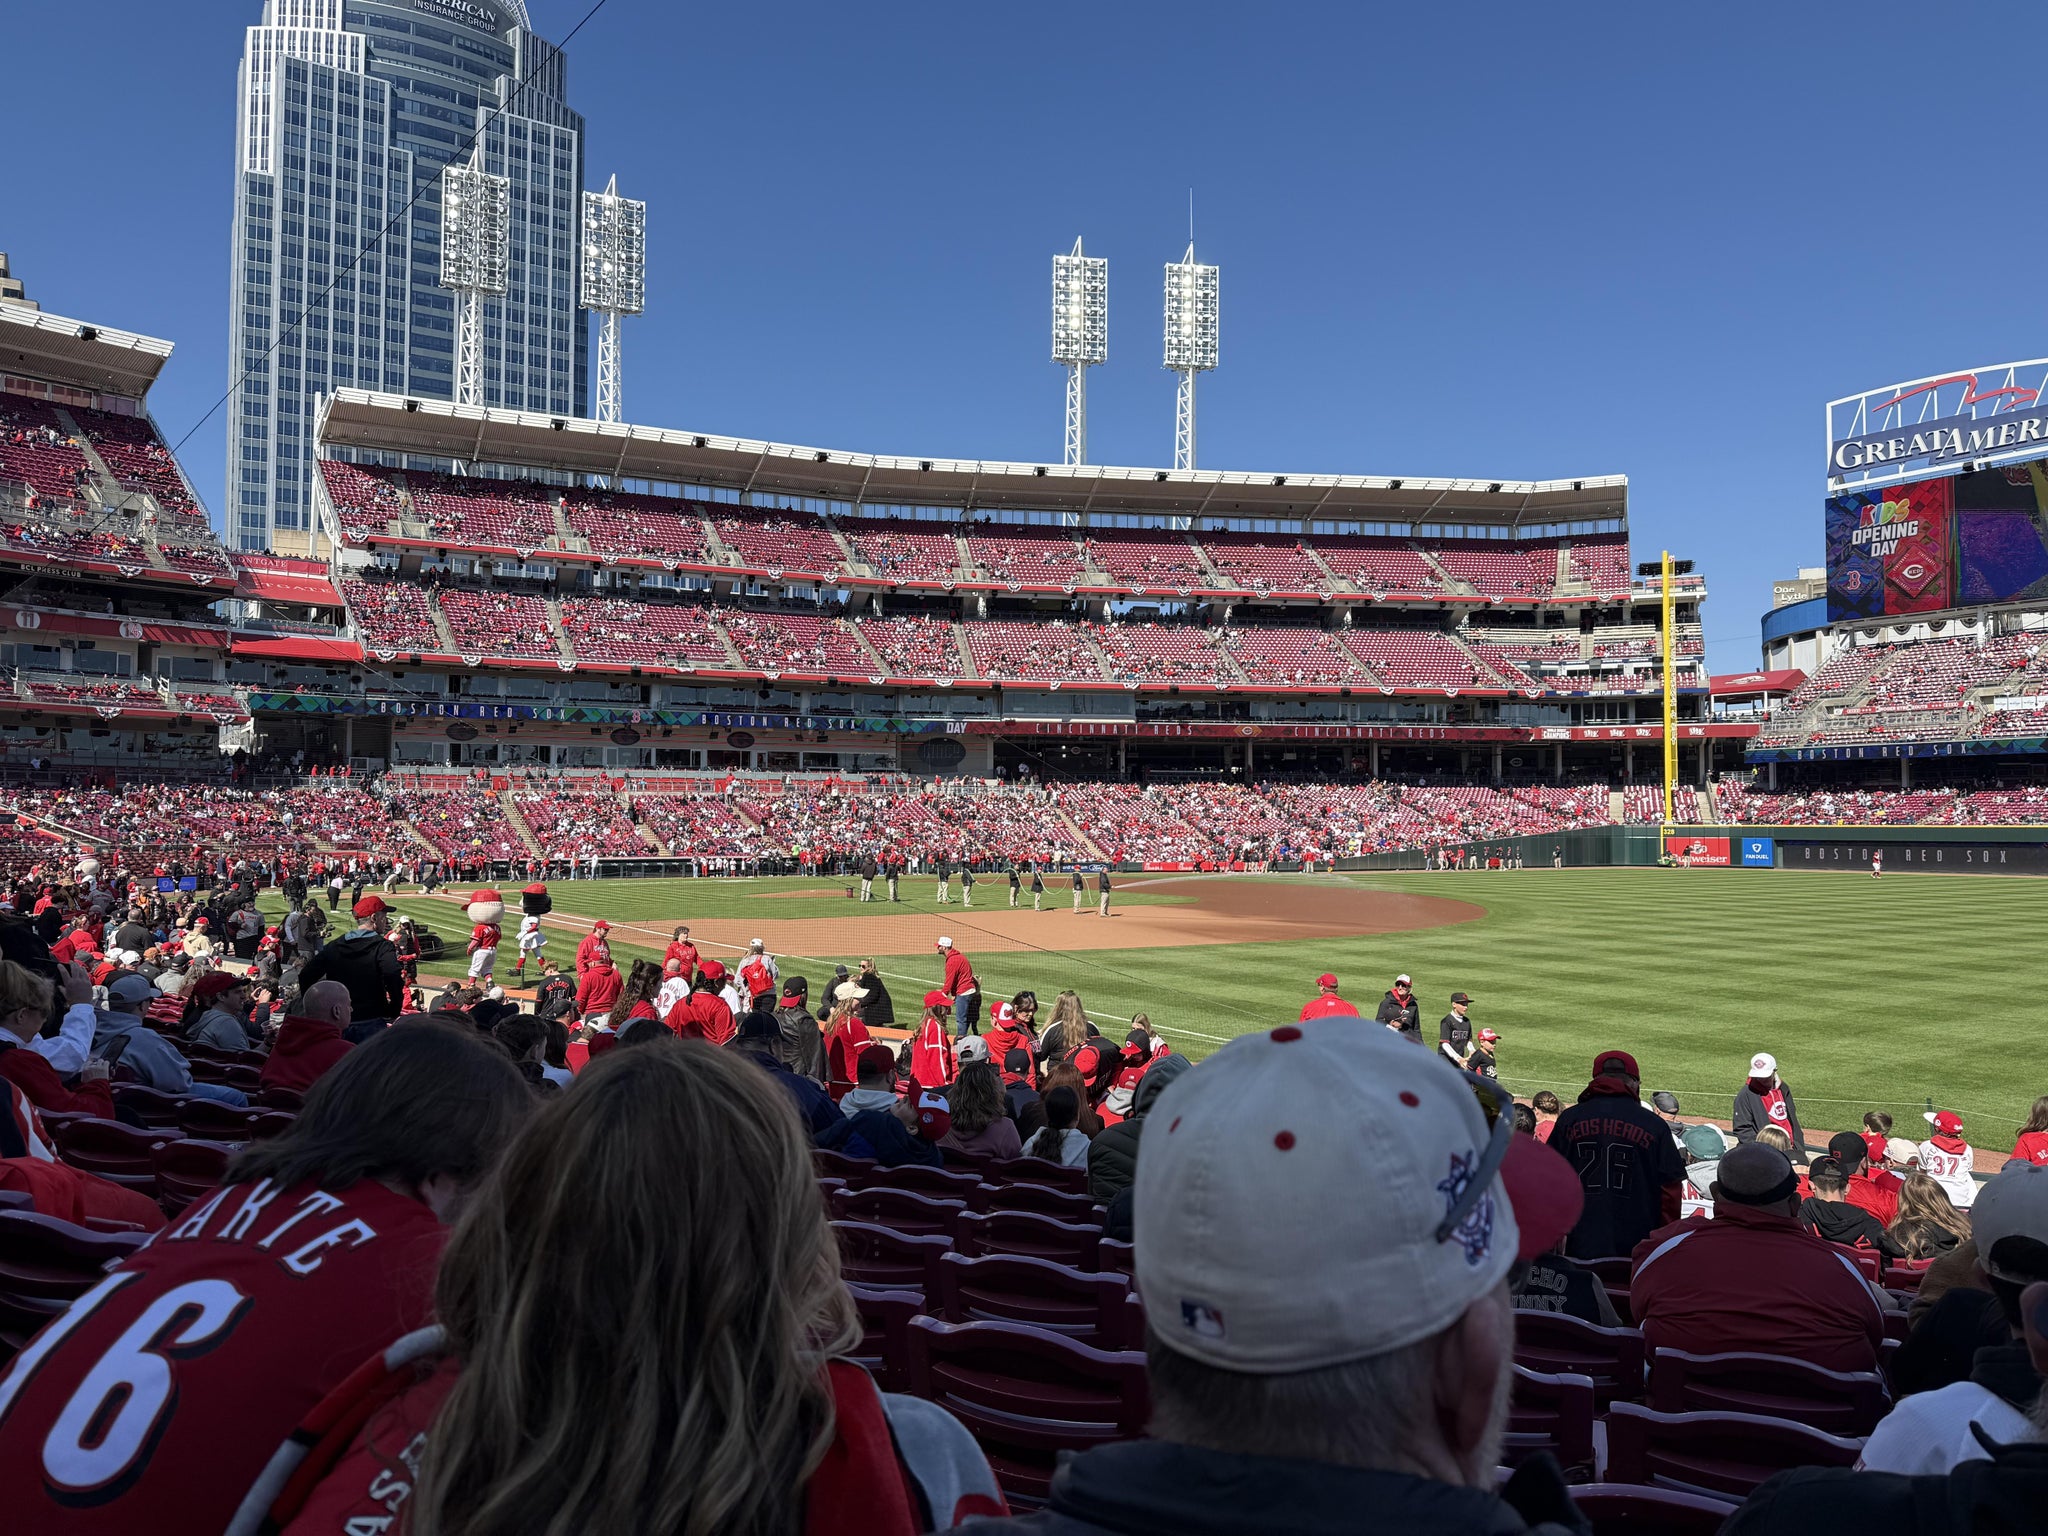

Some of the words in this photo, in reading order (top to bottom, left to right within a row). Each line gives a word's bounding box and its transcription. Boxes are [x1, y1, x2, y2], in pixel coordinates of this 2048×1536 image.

[414, 0, 464, 21] INSURANCE
[468, 16, 496, 32] GROUP
[1835, 427, 1949, 470] GREAT
[1859, 497, 1910, 529] KIDS
[1852, 520, 1919, 545] OPENING
[1871, 539, 1898, 558] DAY
[20, 563, 35, 572] BCL
[37, 566, 60, 575] PRESS
[229, 554, 288, 568] RONTGATE
[1774, 586, 1795, 594] One
[1781, 592, 1809, 602] Lytle
[20, 612, 34, 628] 11
[380, 702, 459, 716] BOSTON
[480, 705, 513, 718] RED
[532, 707, 565, 720] SOX
[701, 714, 768, 727] BOSTON
[784, 717, 812, 728] RED
[828, 718, 856, 729] SOX
[946, 722, 967, 734] DAY
[1035, 723, 1139, 735] CINCINNATI
[1154, 725, 1192, 736] REDS
[1294, 726, 1393, 737] CINCINNATI
[1408, 728, 1445, 739] REDS
[1797, 747, 1863, 760] BOSTON
[1882, 745, 1914, 757] RED
[1933, 743, 1966, 755] SOX
[1673, 853, 1728, 863] Buweiser
[1805, 848, 1883, 860] BOSTON
[1905, 849, 1943, 862] RED
[1966, 850, 2006, 863] SOX
[1577, 1141, 1635, 1199] 26
[1933, 1155, 1959, 1177] 37
[137, 1176, 377, 1276] ARTE
